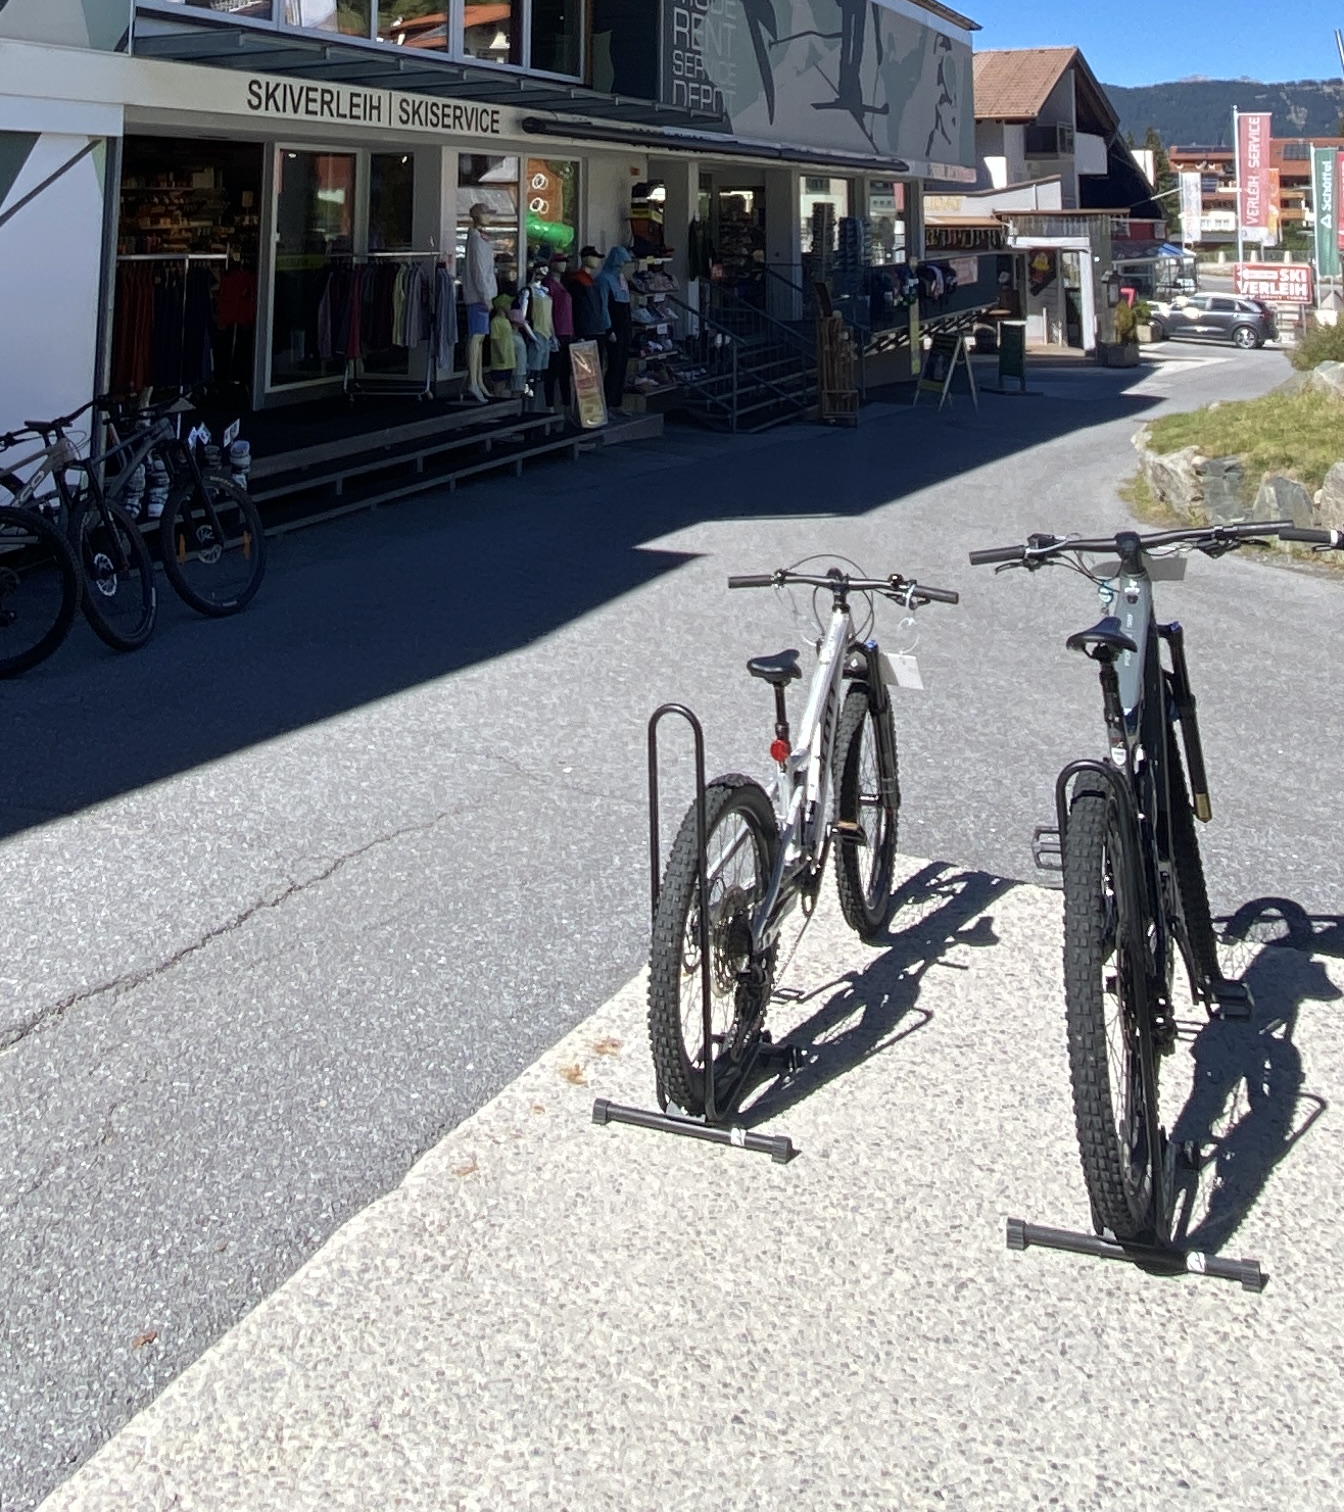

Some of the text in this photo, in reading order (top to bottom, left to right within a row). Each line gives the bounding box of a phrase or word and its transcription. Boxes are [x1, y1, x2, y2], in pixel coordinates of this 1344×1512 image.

[673, 7, 737, 59] RENT
[672, 50, 737, 87] SERVICE
[247, 79, 501, 134] SKIVERLEIH SKISERVICE
[1245, 116, 1261, 225] VERLEIH SERVICE
[1237, 280, 1308, 296] VERLEIH
[1279, 268, 1307, 283] SKI
